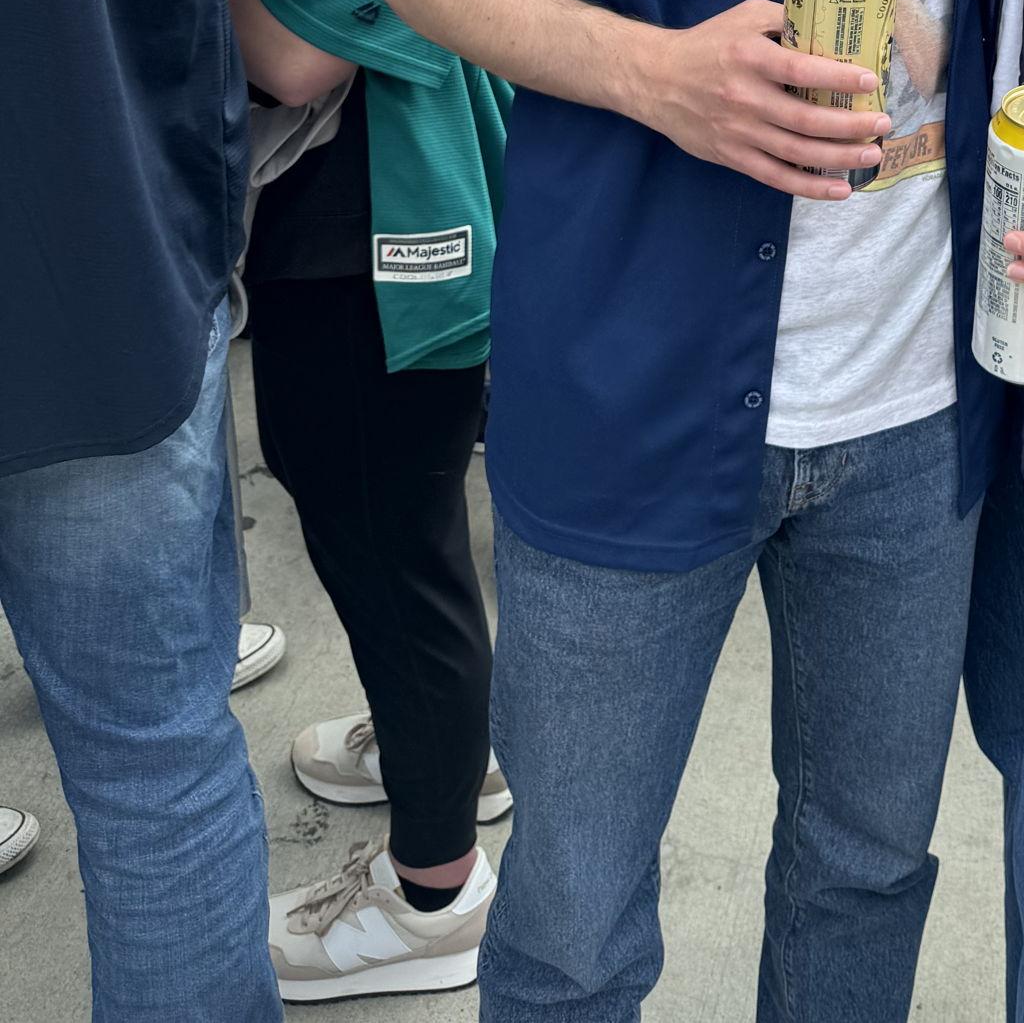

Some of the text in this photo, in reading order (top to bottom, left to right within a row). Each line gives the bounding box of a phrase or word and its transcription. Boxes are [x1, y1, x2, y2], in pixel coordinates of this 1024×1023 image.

[1002, 167, 1020, 182] Facts
[1005, 194, 1018, 207] 210
[407, 241, 461, 260] Majestic
